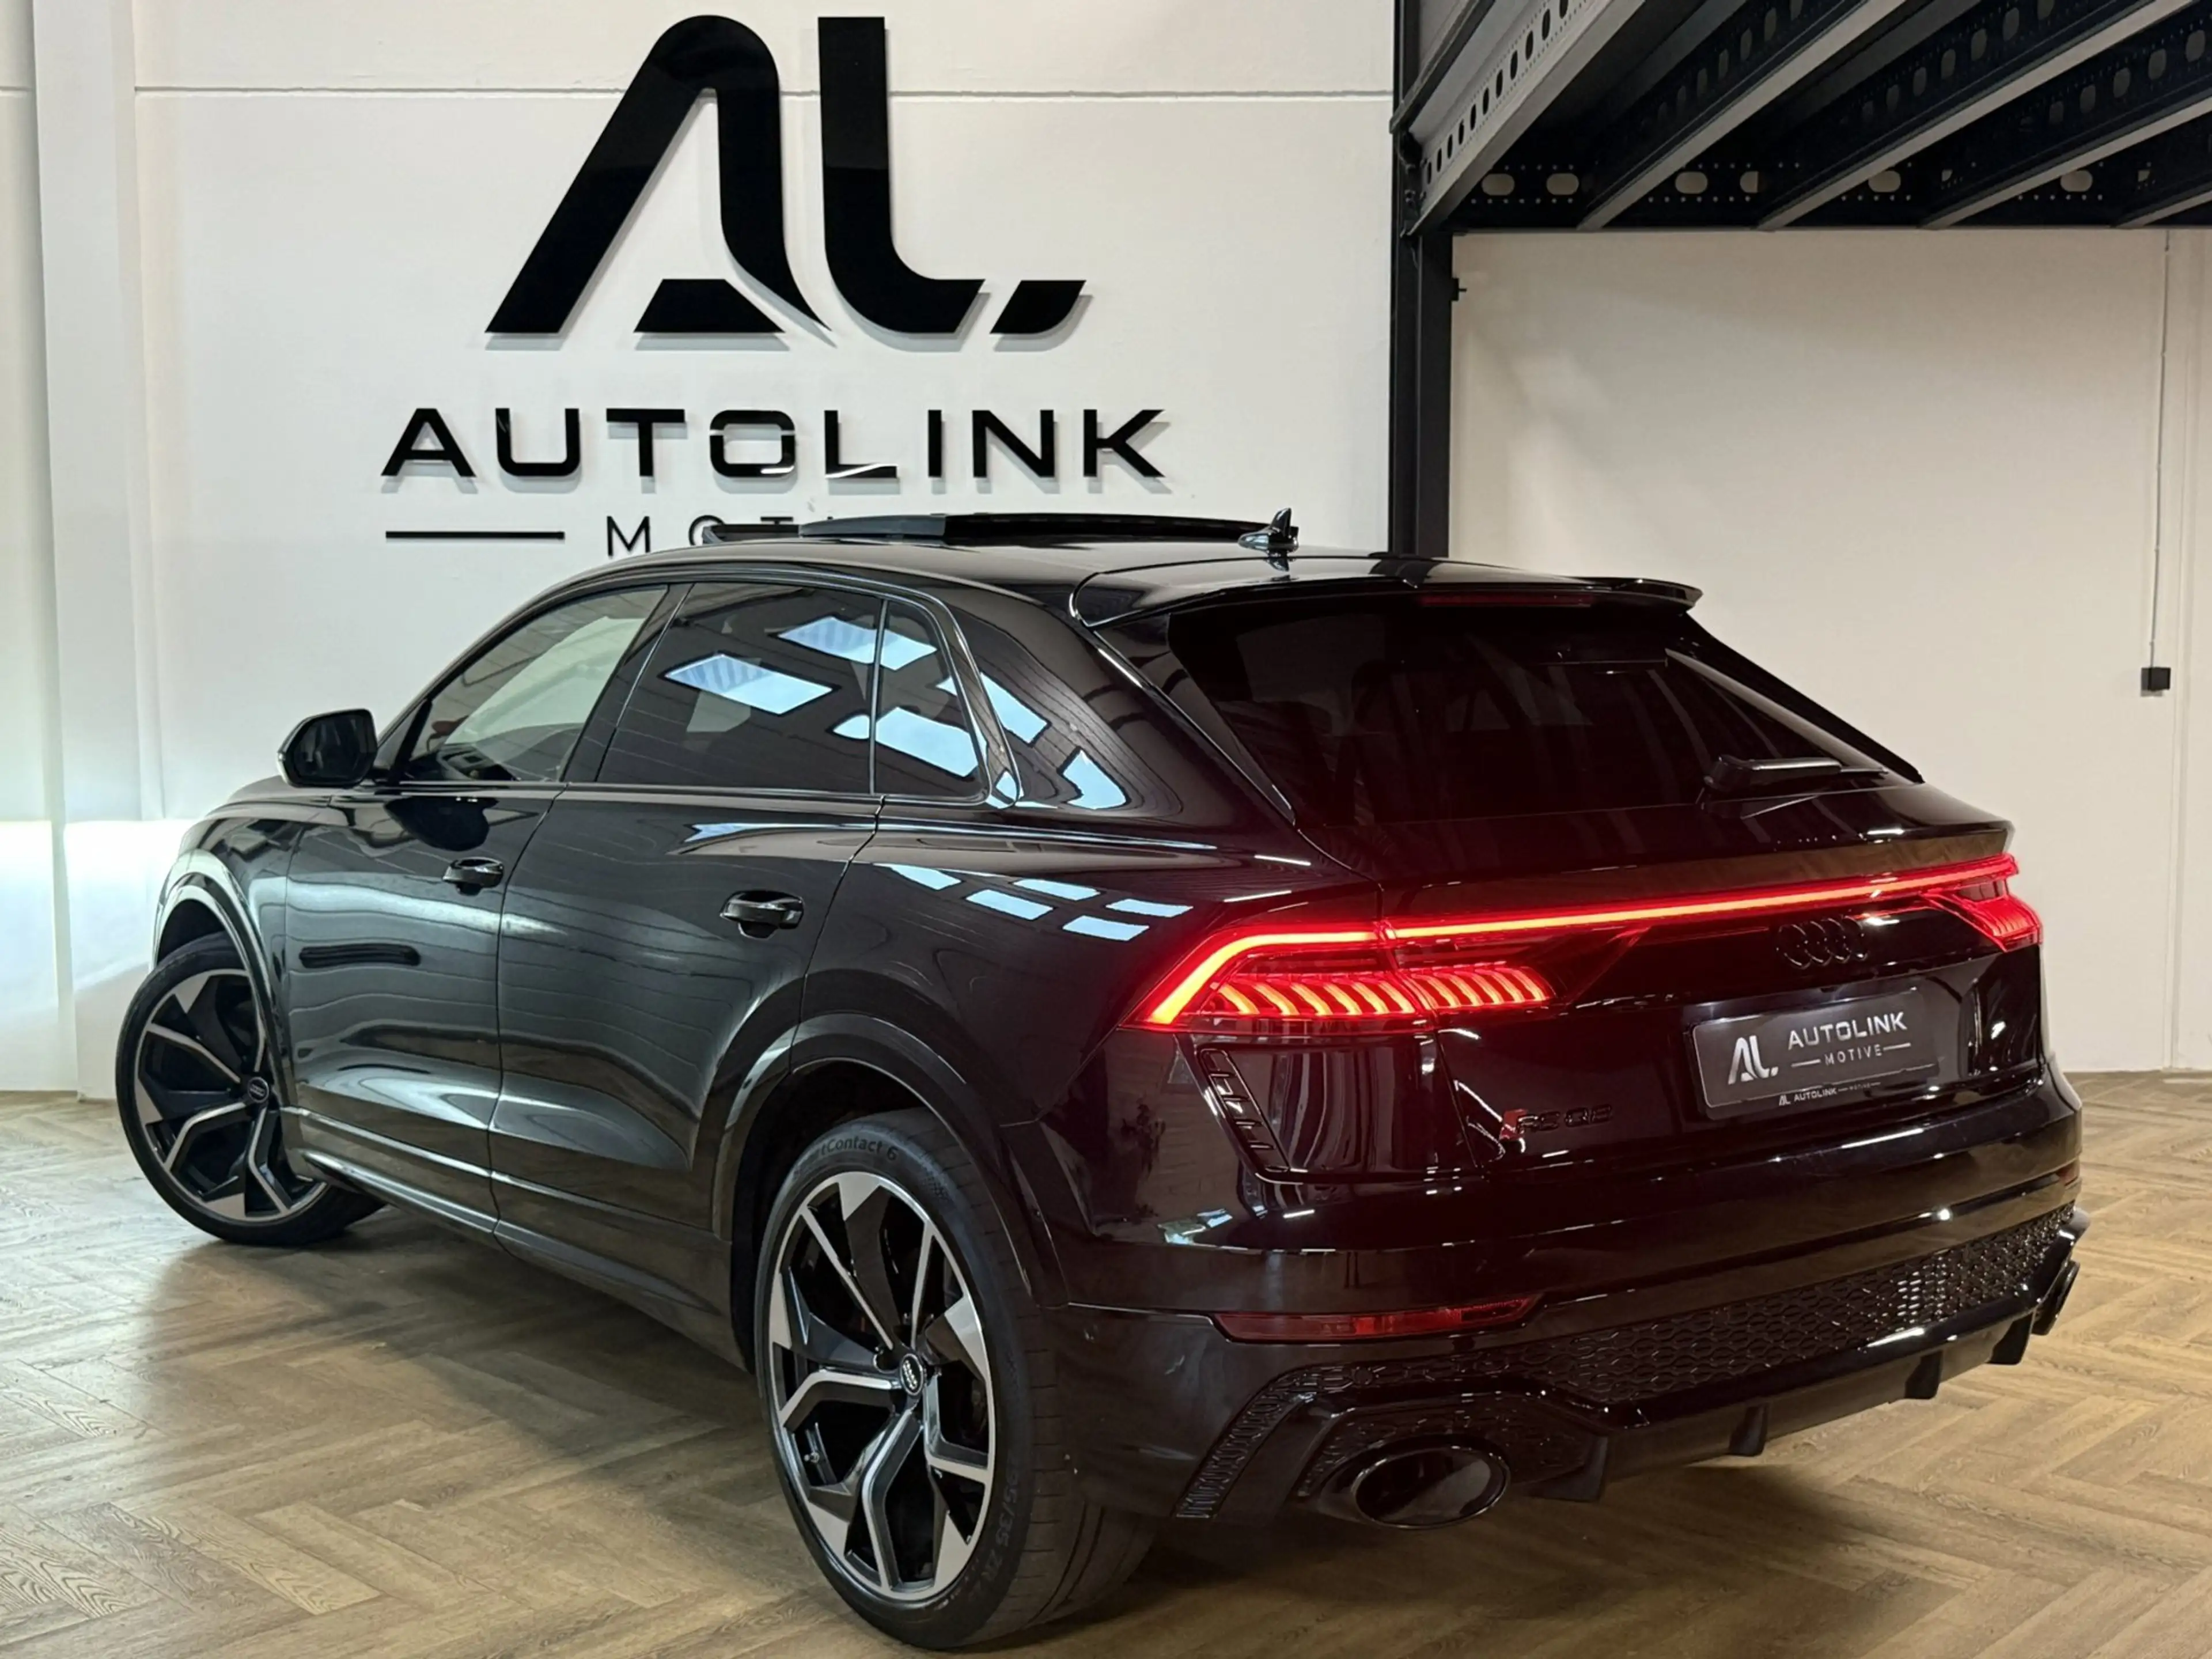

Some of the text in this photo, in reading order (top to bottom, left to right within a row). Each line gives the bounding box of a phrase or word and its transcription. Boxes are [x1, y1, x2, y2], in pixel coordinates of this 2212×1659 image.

[381, 407, 1164, 479] AUTOLINK
[1788, 1012, 1908, 1051] AUTOLINK
[1824, 1044, 1883, 1066] MOTIVE
[1794, 1088, 1838, 1102] AUTOLINK
[887, 1146, 899, 1161] 6
